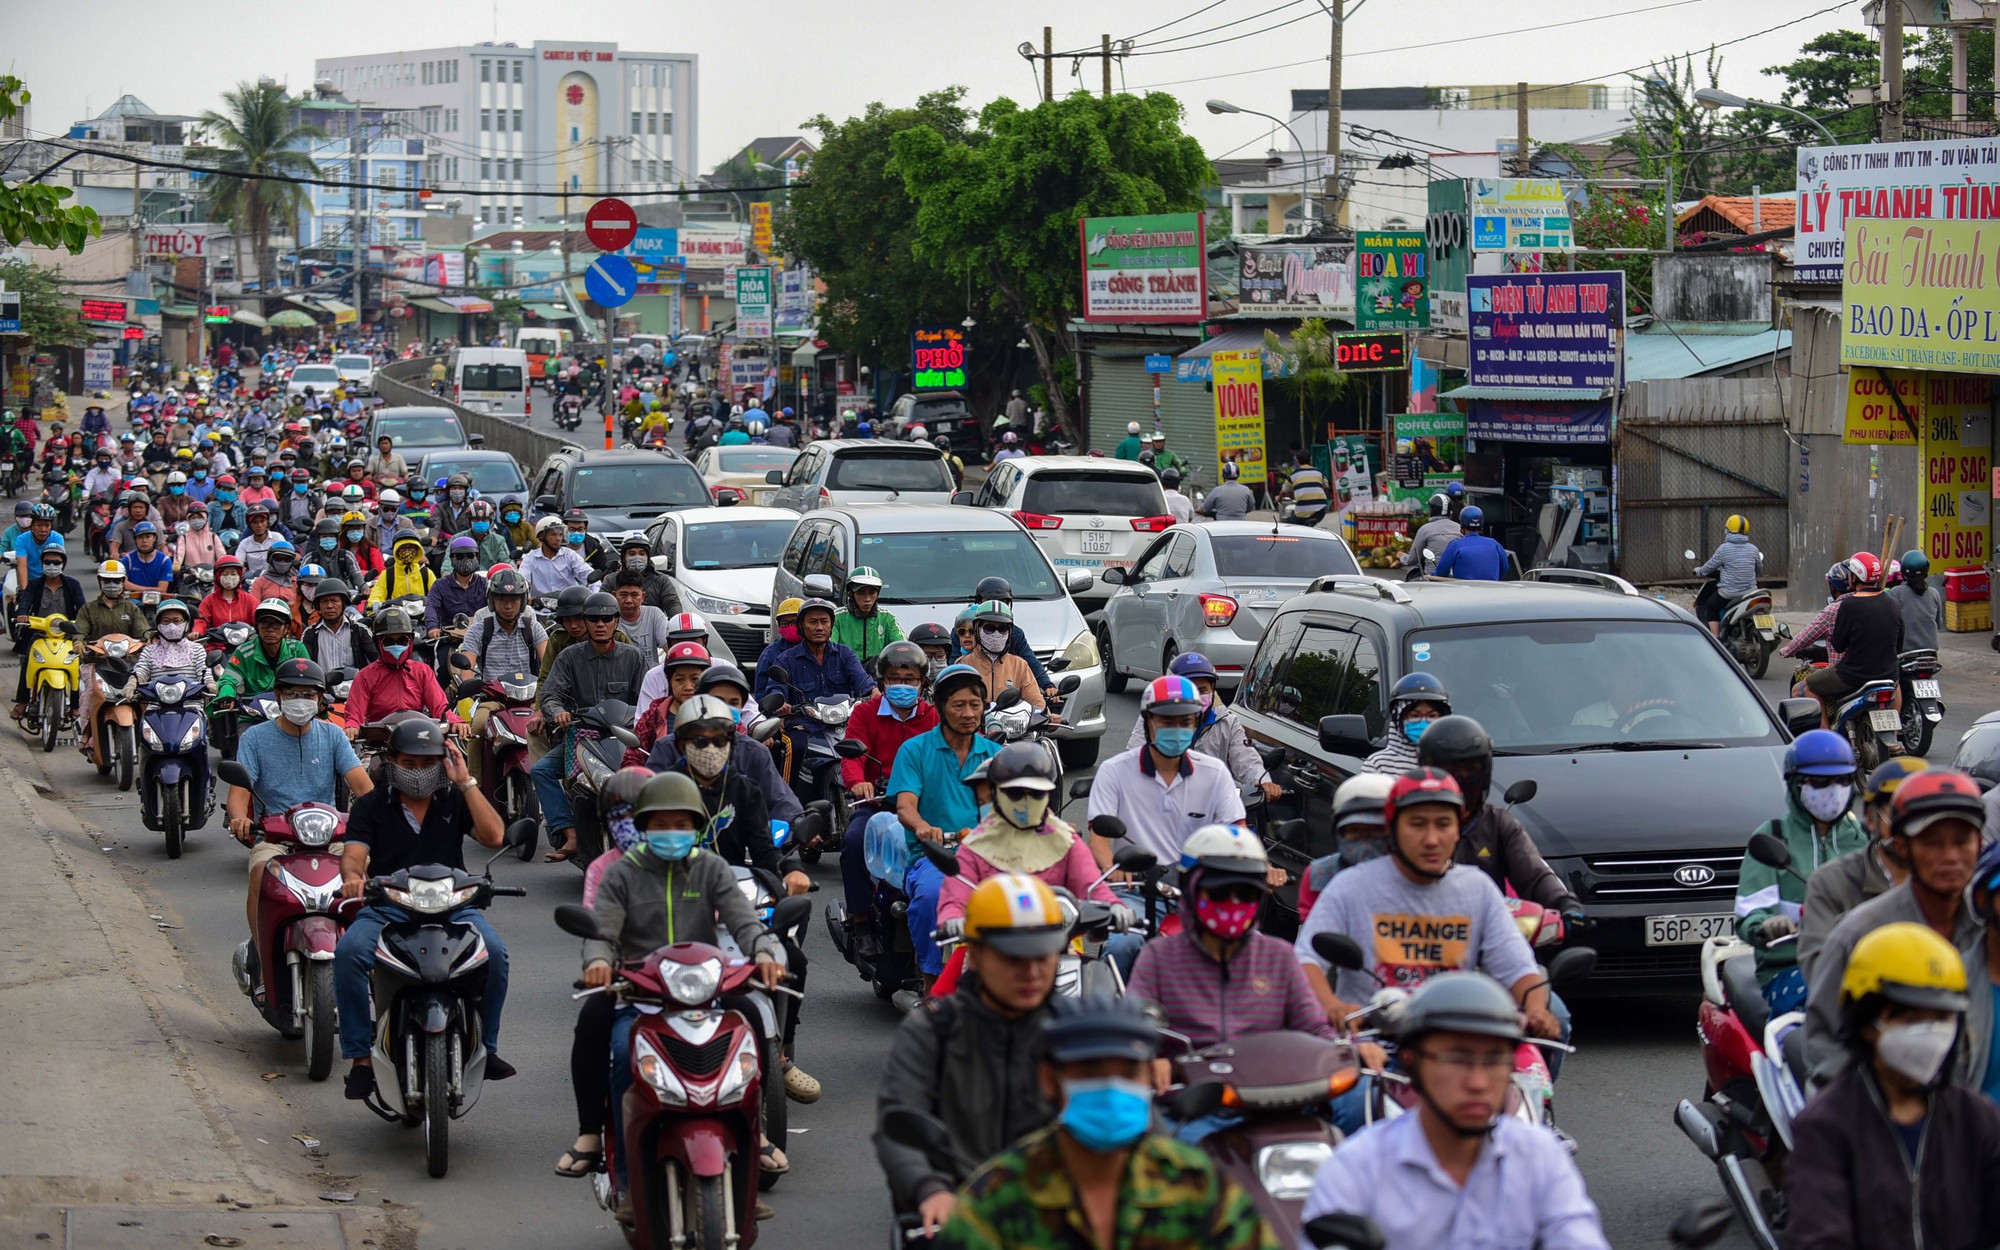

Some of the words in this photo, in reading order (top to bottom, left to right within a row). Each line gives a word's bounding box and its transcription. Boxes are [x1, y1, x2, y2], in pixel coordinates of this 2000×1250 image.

[1823, 152, 1848, 171] CÔNG
[1851, 154, 1864, 169] TY
[1865, 152, 1889, 168] TNHH
[1894, 151, 1914, 167] MTV
[1918, 150, 1932, 167] TM
[1942, 149, 1955, 166] DV
[1958, 144, 1978, 168] VẬN
[1981, 142, 1997, 164] TẢI
[1799, 180, 1831, 232] LÝ
[1838, 187, 1932, 231] THANH
[1524, 218, 1541, 227] LONG
[635, 239, 663, 250] INAX
[1152, 232, 1175, 248] NAM
[1176, 231, 1195, 247] KIM
[1364, 234, 1393, 247] MẦM
[1397, 238, 1420, 247] NON
[1403, 253, 1424, 277] MI
[1850, 226, 1890, 285] Sài
[1902, 225, 1986, 289] Thành
[741, 278, 764, 291] HÒA
[1108, 271, 1144, 293] CÔNG
[1148, 268, 1197, 293] THÀNH
[1492, 280, 1524, 321] ĐIỆN
[1526, 277, 1544, 314] TỬ
[1547, 284, 1577, 314] ANH
[1579, 283, 1608, 314] THƯ
[1850, 304, 1894, 336] BAO
[1900, 307, 1930, 338] DA
[1947, 295, 1977, 340] ỐP
[1556, 324, 1574, 338] MUA
[1575, 322, 1590, 338] BÁN
[1592, 324, 1606, 338] TIVI
[915, 339, 964, 369] PHỞ
[1337, 343, 1383, 362] one
[1845, 344, 1890, 360] FACEBOOK:
[1890, 344, 1904, 362] SÀI
[1906, 346, 1934, 364] THÀNH
[1936, 350, 1956, 366] CASE
[1962, 352, 1980, 367] HOT
[1218, 377, 1259, 419] VÕNG
[1930, 379, 1948, 405] TAI
[1953, 378, 1988, 405] NGHE
[1397, 421, 1430, 430] COFFEE
[1433, 420, 1463, 429] QUEEN
[1932, 416, 1958, 441] 30k
[1930, 452, 1955, 484] CÁP
[1960, 456, 1986, 489] SẠC
[1930, 493, 1956, 517] 40k
[1088, 532, 1104, 541] 51H
[1932, 523, 1950, 559] CỦ
[1956, 532, 1983, 564] SẠC
[1680, 869, 1708, 881] KIA
[1376, 921, 1468, 940] CHANGE
[1400, 943, 1442, 961] THE
